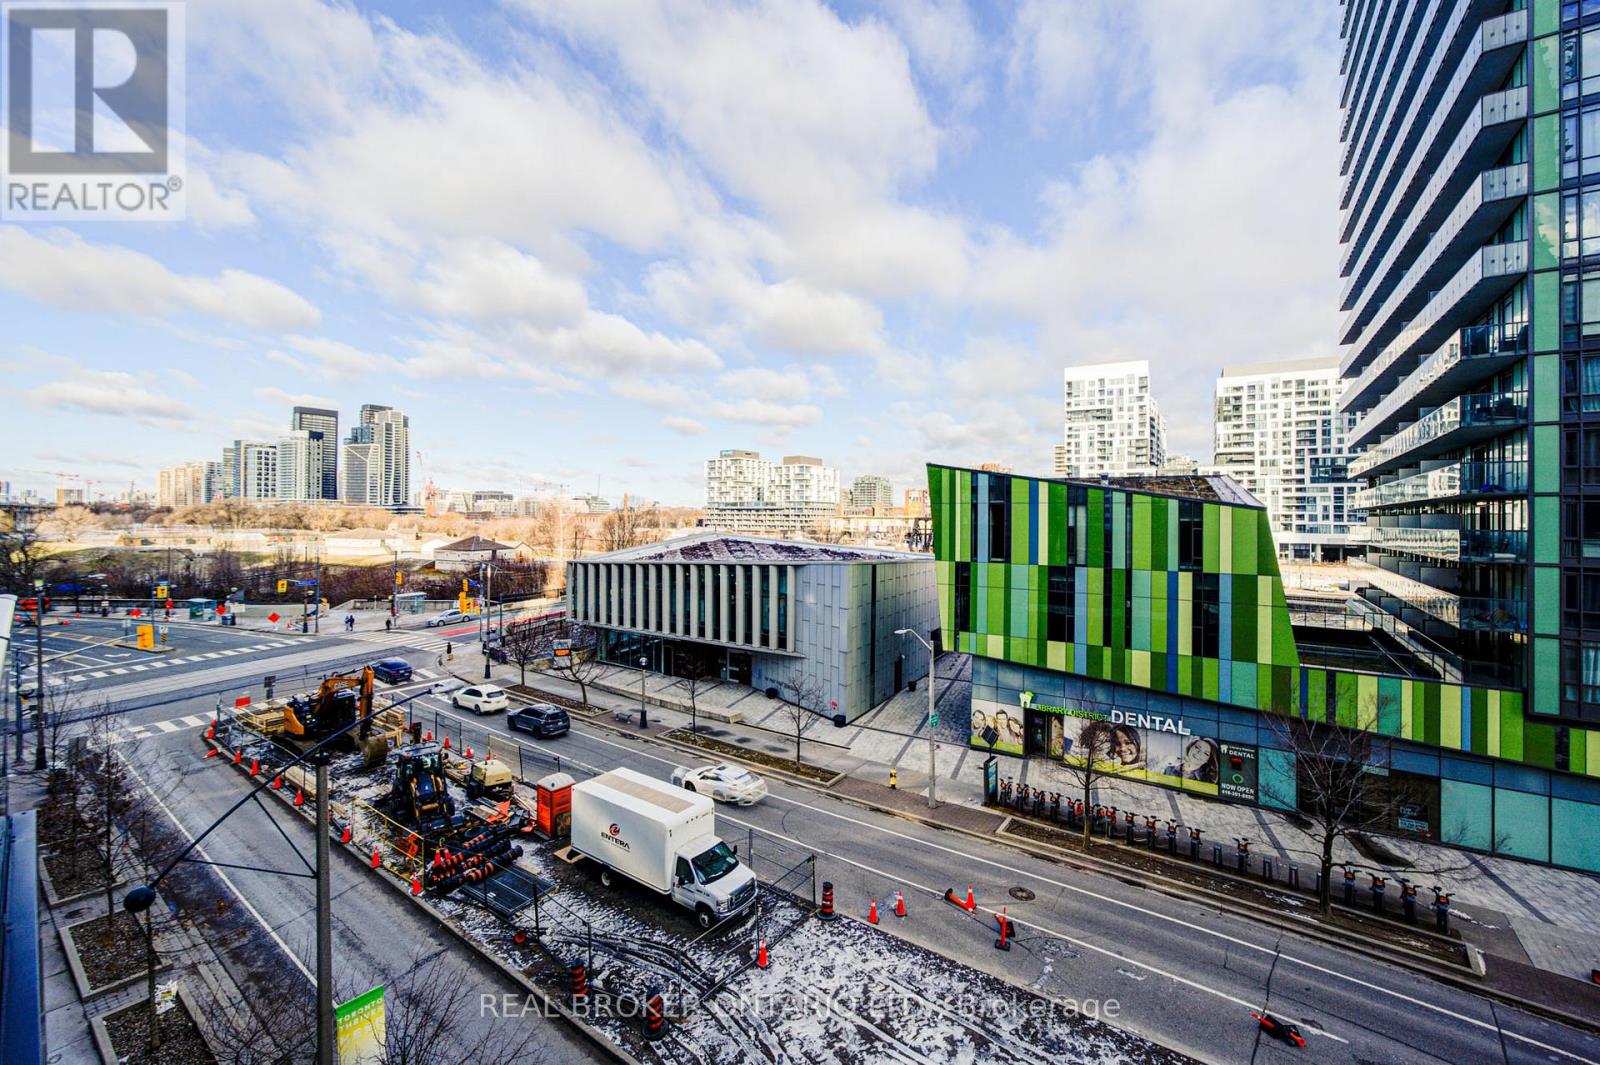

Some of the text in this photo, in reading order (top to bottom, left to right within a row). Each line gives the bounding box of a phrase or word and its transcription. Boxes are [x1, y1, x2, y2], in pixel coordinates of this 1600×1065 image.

[1034, 703, 1191, 736] LIBRARY DISTRICT DENTAL
[1228, 749, 1256, 760] DENTAL
[1221, 783, 1255, 795] NOW OPEN
[601, 832, 630, 849] ENTERA
[339, 997, 383, 1024] TORONTO
